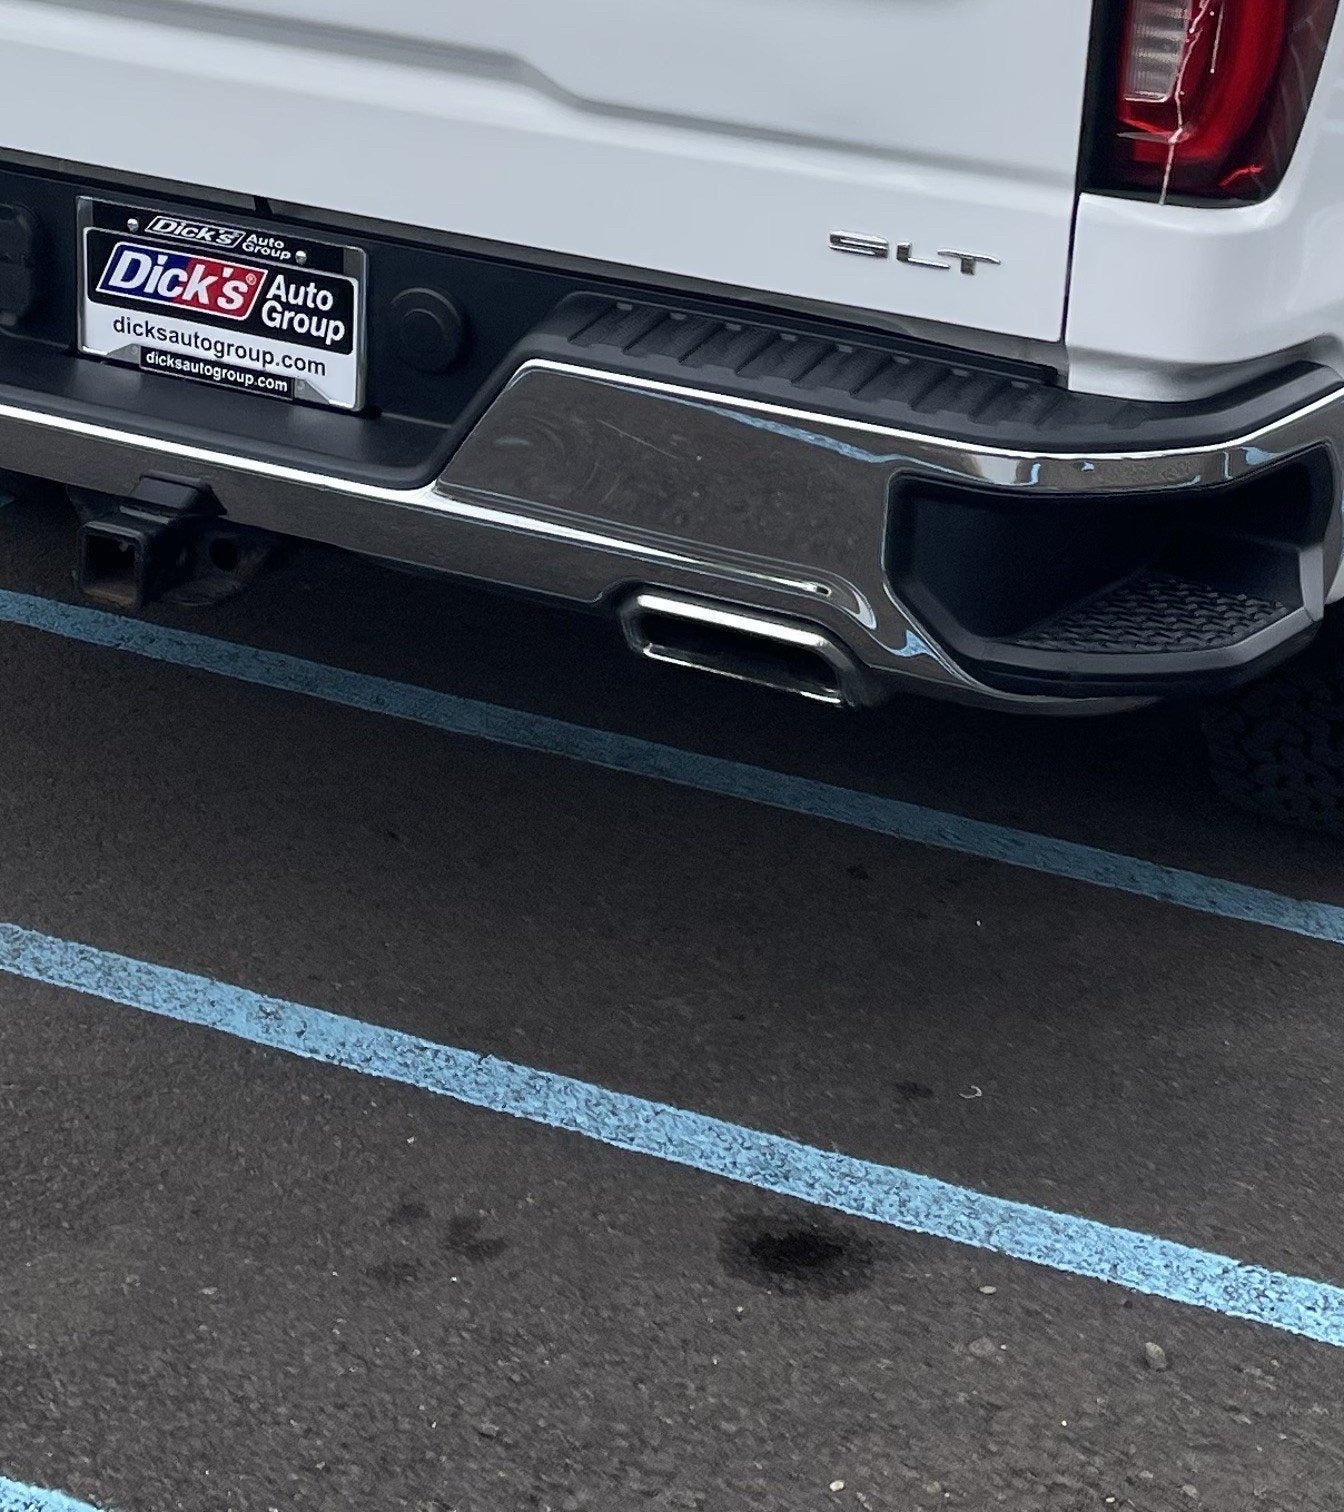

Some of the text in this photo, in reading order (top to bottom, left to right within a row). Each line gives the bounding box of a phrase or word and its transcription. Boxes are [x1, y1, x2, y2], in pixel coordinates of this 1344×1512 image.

[152, 219, 236, 246] Dick's
[242, 242, 292, 261] Group
[245, 234, 285, 249] Auto
[829, 230, 1001, 275] SLT
[108, 250, 249, 311] Dick's
[266, 274, 334, 311] Auto
[261, 300, 346, 345] Group
[113, 316, 327, 377] dicksautogroup.com
[146, 351, 289, 392] dicksautogroup.com
